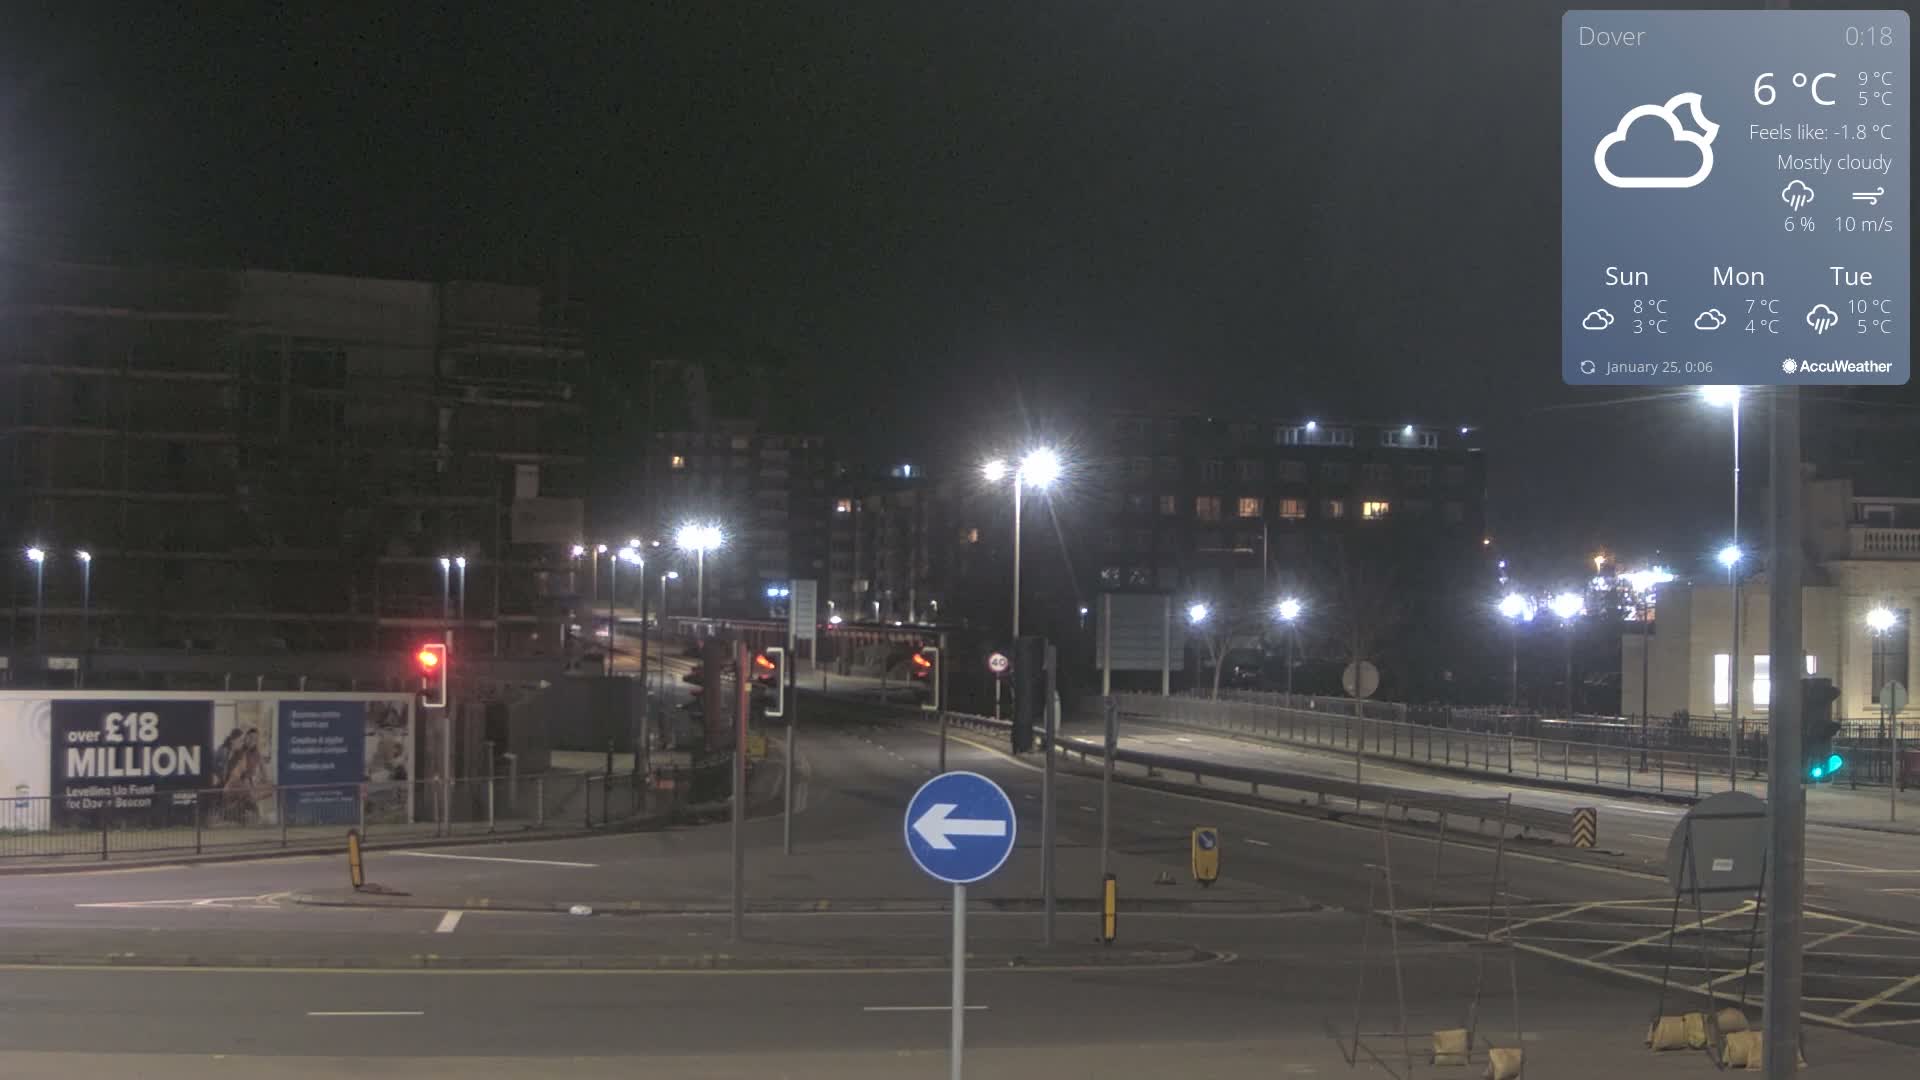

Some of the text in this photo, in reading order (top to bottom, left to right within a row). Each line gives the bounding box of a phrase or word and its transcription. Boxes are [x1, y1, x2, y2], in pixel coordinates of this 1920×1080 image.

[991, 658, 1006, 667] 40
[68, 711, 159, 742] over £18
[67, 745, 201, 778] MILLION
